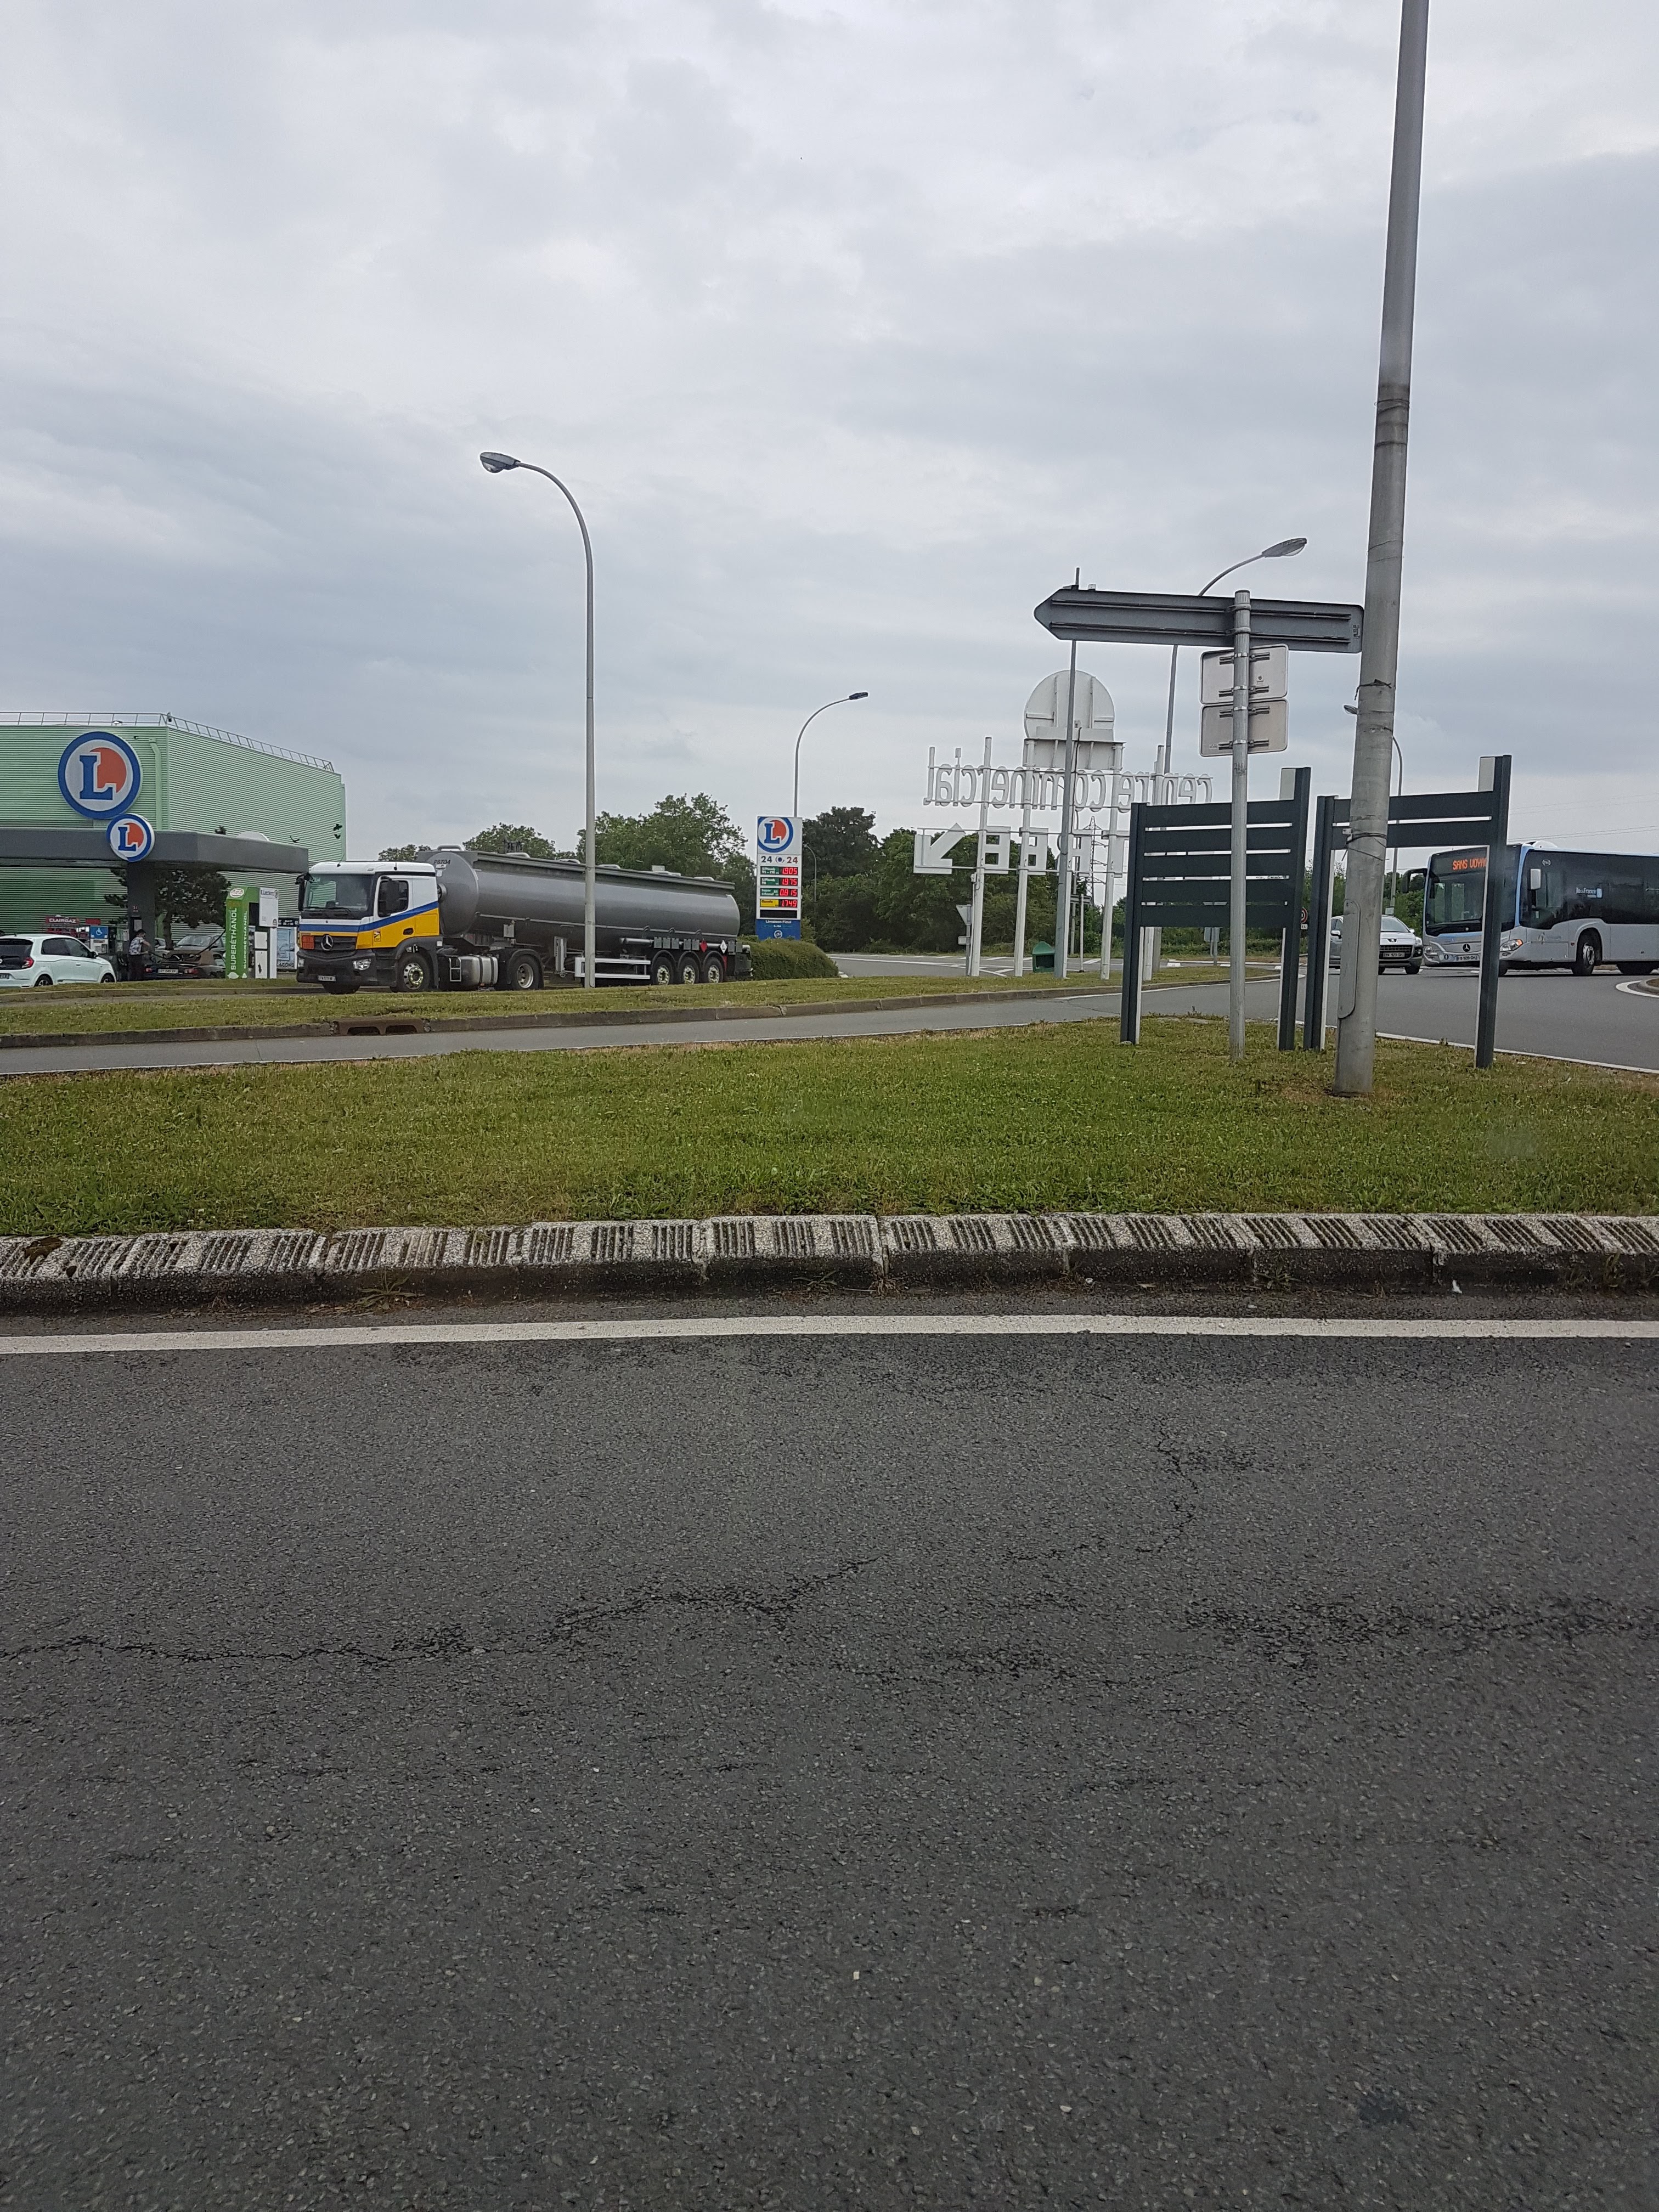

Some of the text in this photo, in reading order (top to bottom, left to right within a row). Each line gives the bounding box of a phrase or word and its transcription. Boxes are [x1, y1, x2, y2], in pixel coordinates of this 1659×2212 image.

[80, 755, 113, 800] L
[118, 827, 136, 851] L
[764, 823, 780, 844] L
[1453, 859, 1468, 870] SANS
